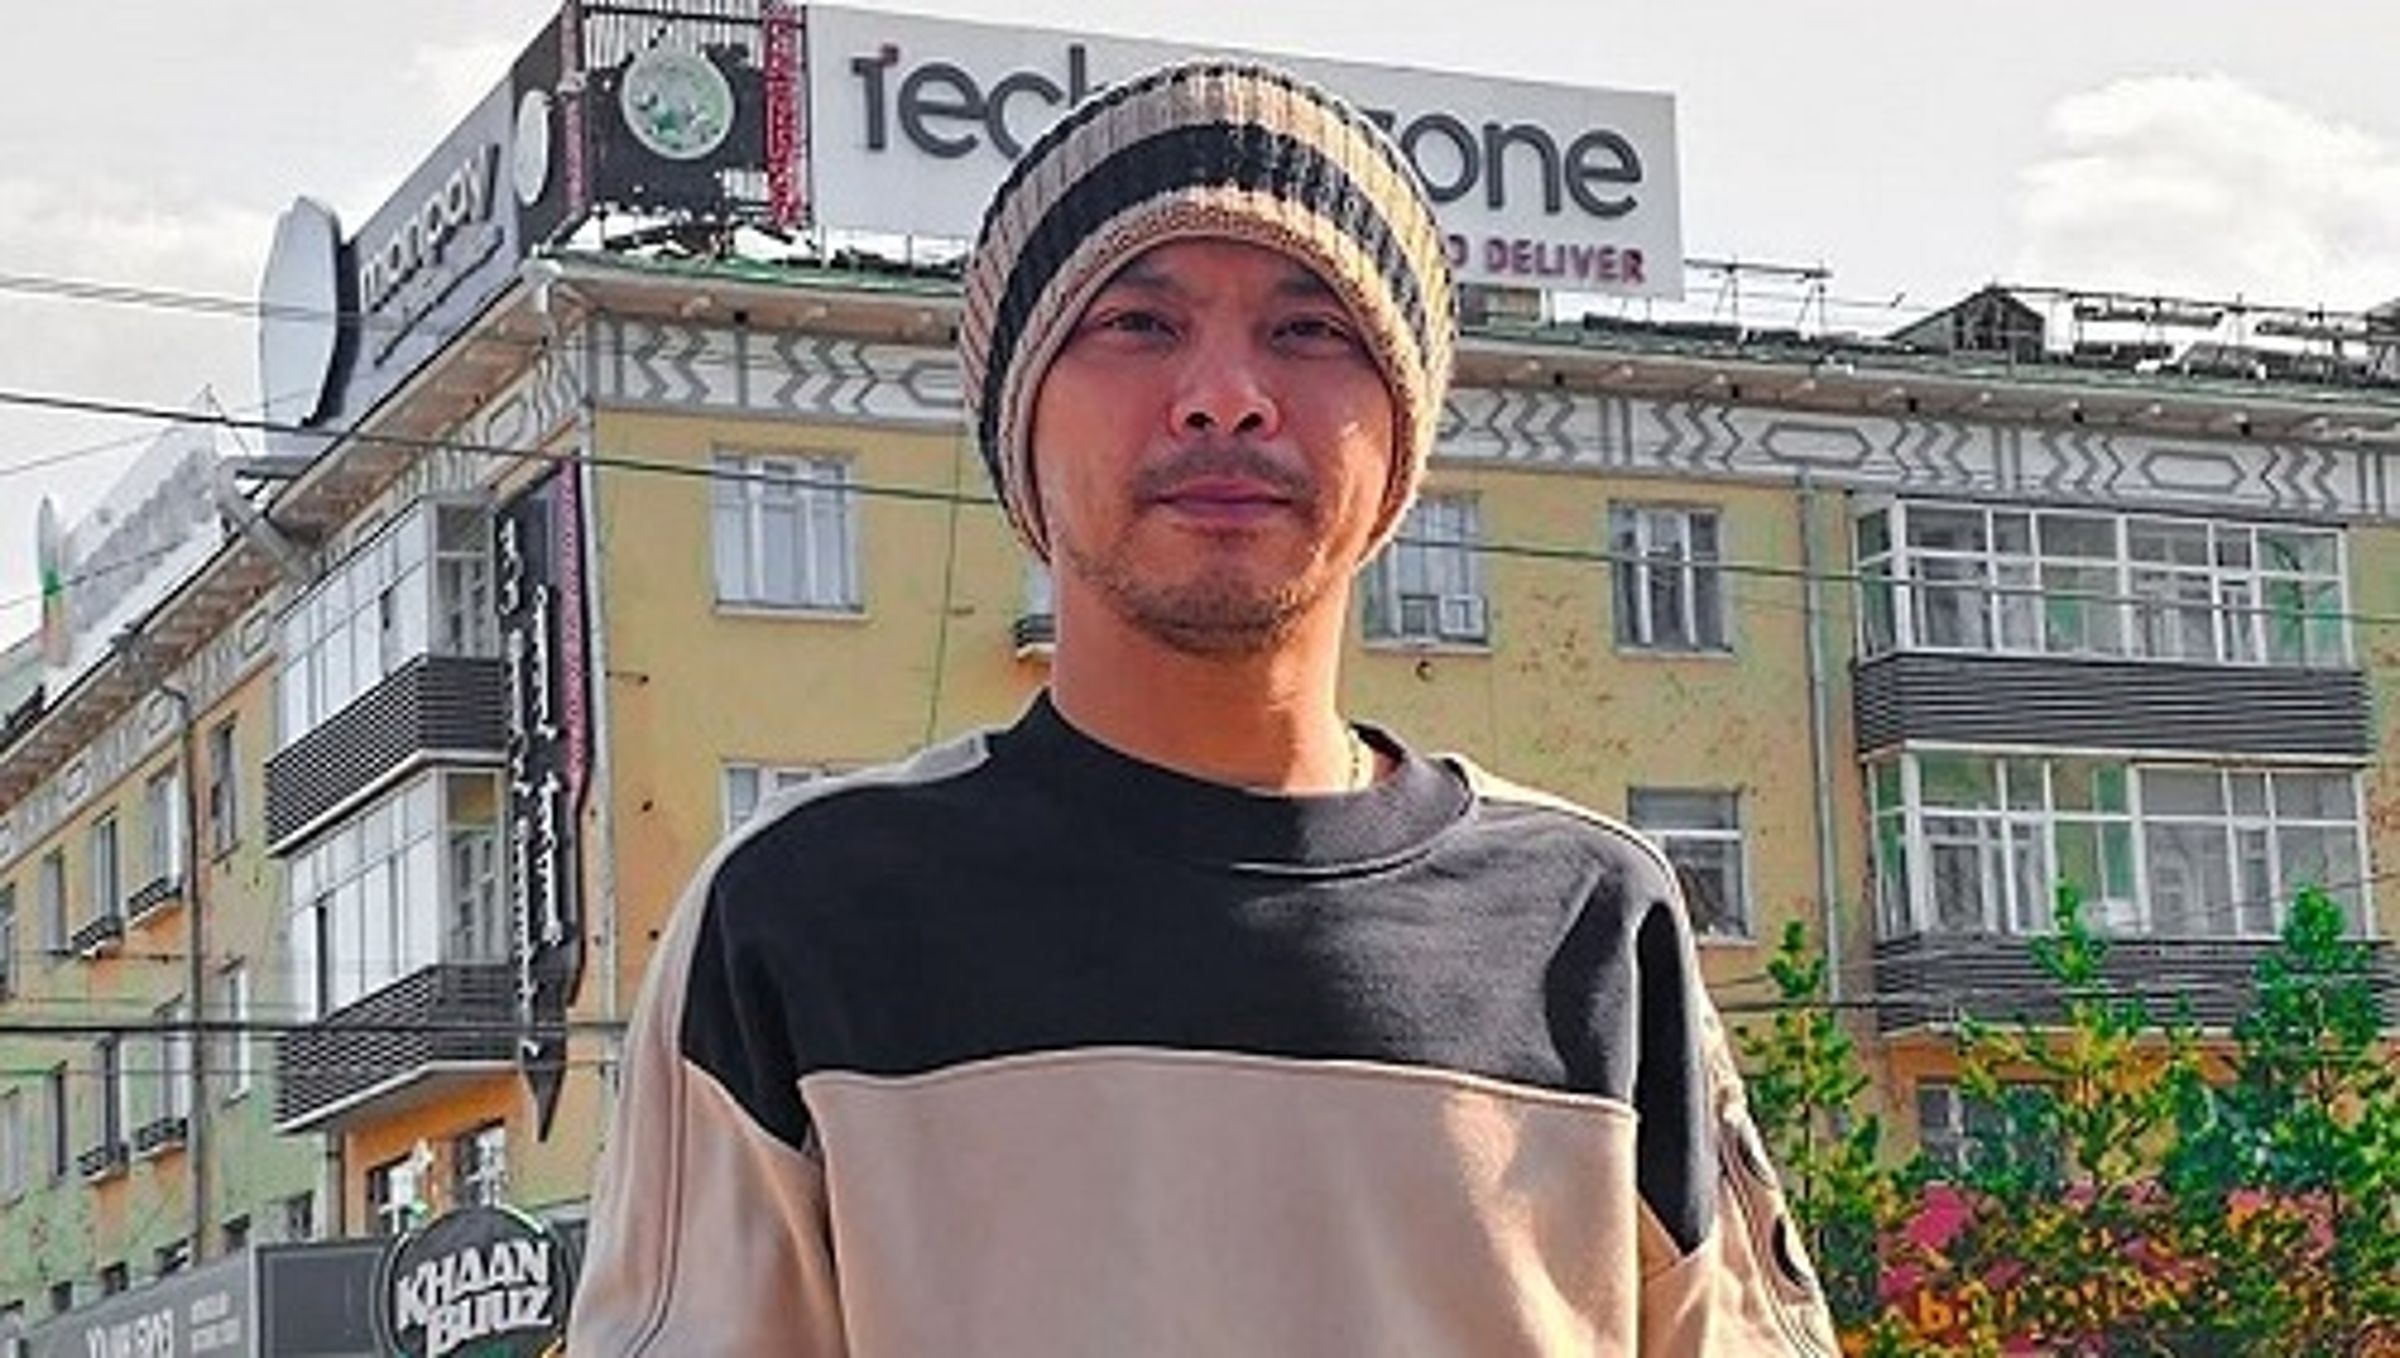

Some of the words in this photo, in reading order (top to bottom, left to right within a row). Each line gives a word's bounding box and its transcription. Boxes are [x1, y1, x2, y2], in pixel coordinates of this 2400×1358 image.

[1486, 238, 1645, 284] DELIVER
[397, 1239, 550, 1331] KHAAN
[426, 1287, 552, 1357] BUUZ
